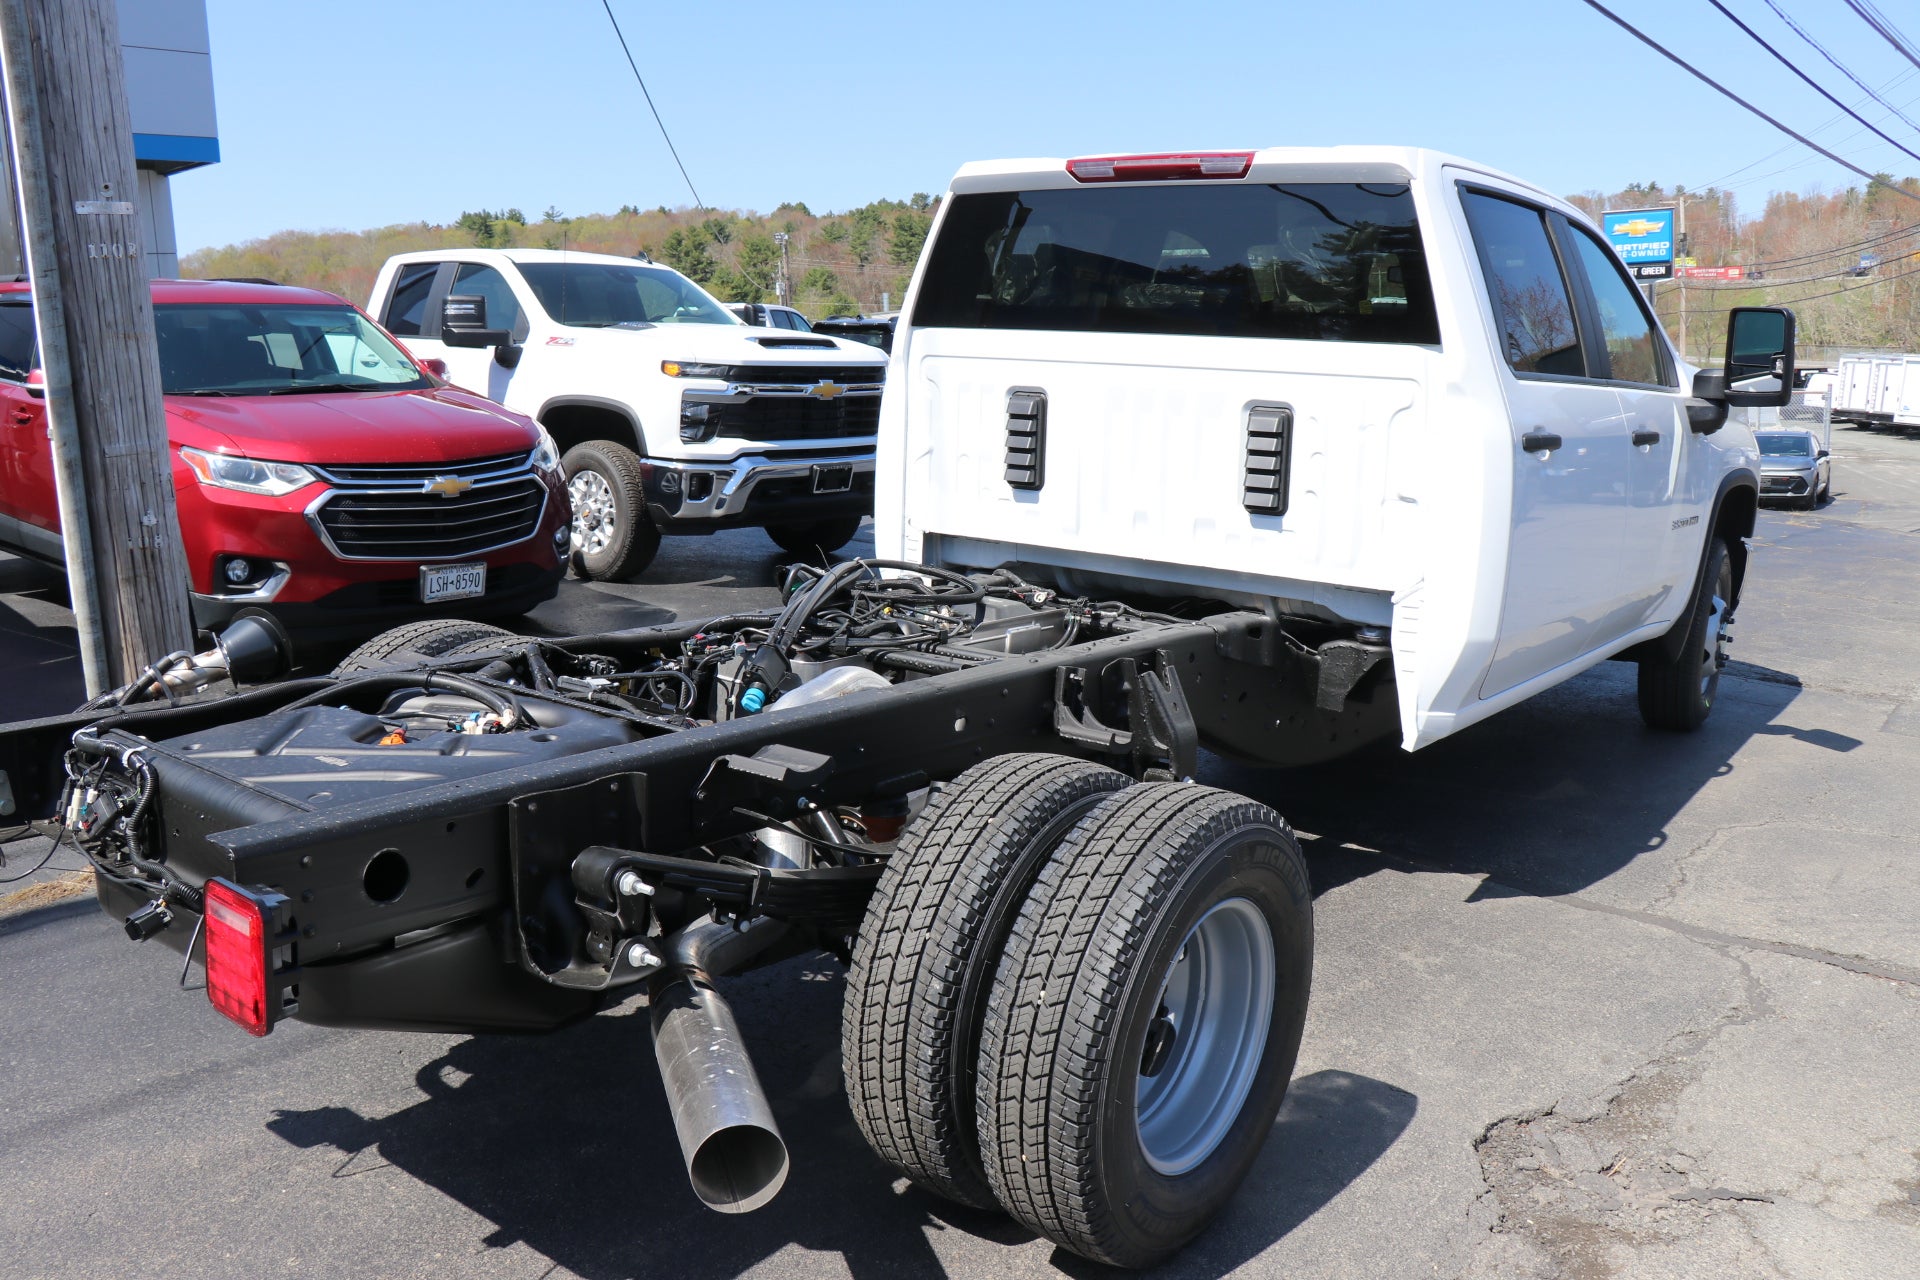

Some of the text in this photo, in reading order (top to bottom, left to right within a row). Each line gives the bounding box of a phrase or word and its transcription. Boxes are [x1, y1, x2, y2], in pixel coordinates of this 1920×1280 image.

[1615, 241, 1670, 252] ERTIFIED
[1619, 249, 1667, 258] E-OWNED
[1641, 266, 1666, 276] GREEN
